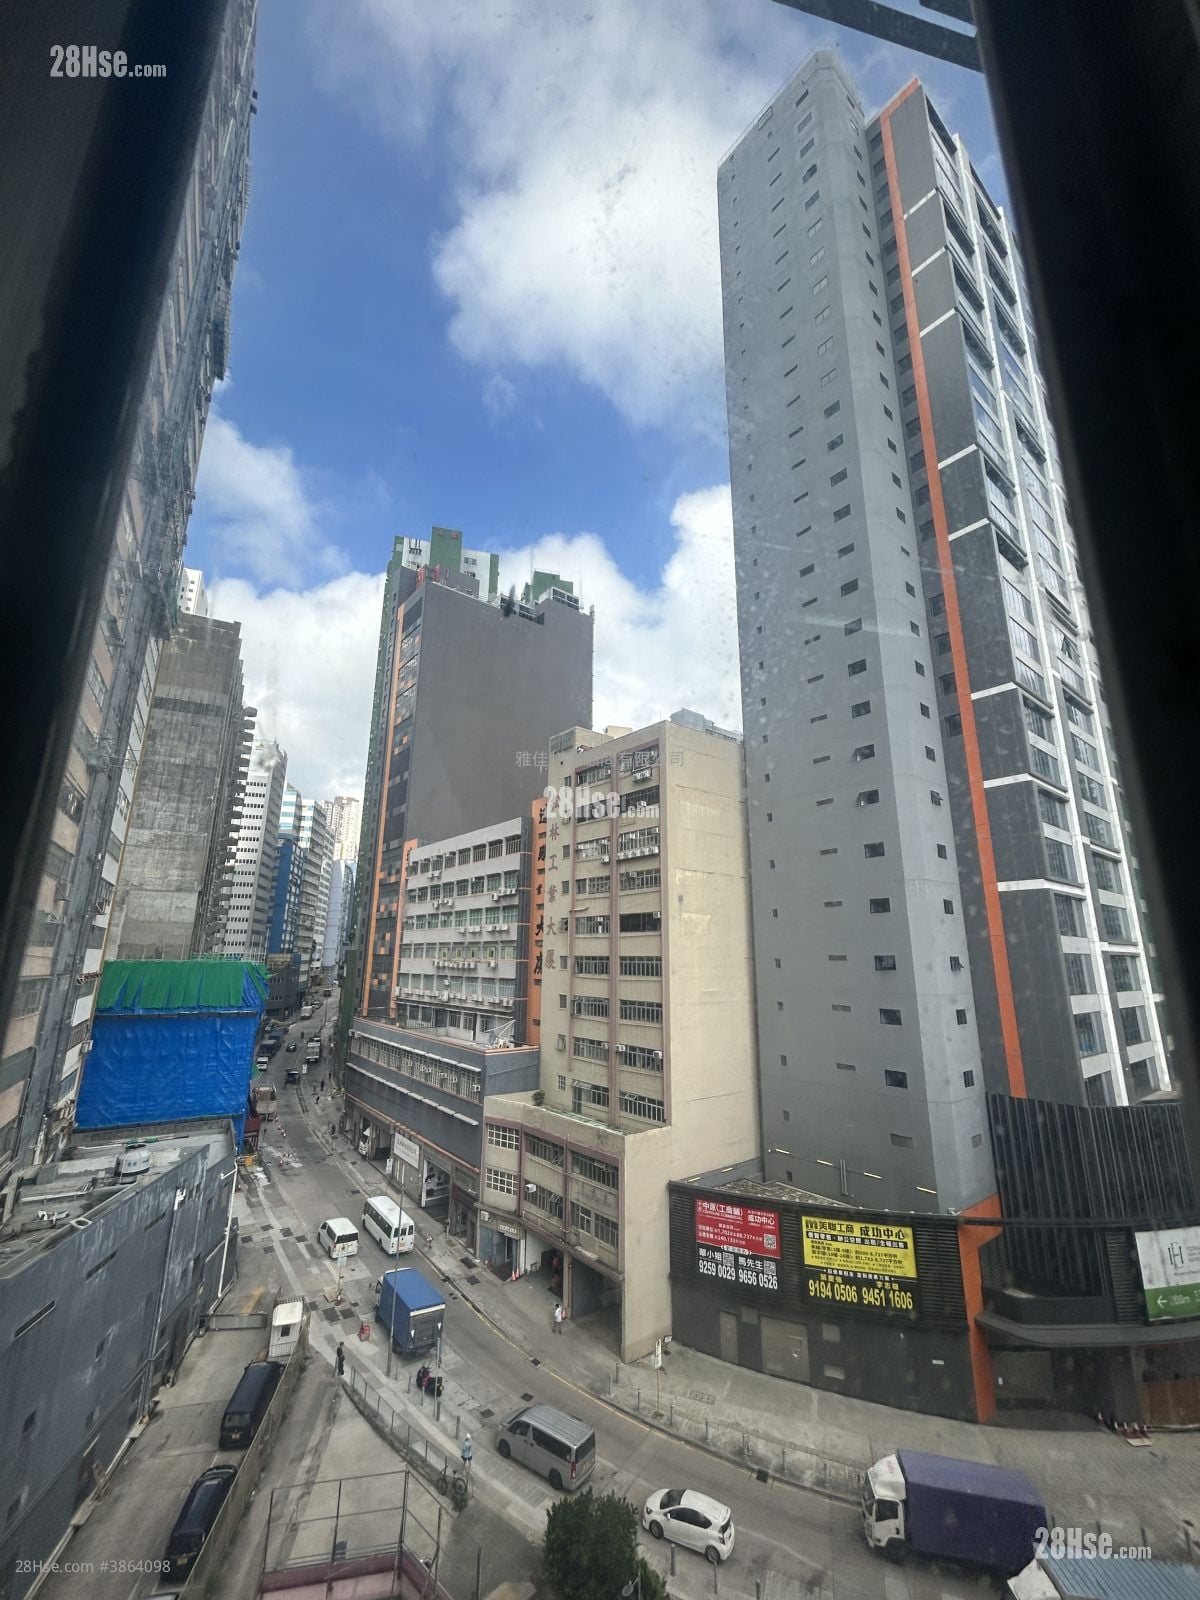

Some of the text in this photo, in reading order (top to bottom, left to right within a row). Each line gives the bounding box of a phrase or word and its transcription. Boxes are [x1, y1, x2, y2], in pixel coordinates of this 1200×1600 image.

[748, 1214, 775, 1225] 成功中心
[859, 1226, 906, 1240] 成功中心
[698, 1260, 716, 1276] 9259
[717, 1264, 736, 1281] 0029
[738, 1256, 764, 1270] 馬先生
[738, 1269, 757, 1286] 9656
[758, 1273, 778, 1290] 0526
[808, 1279, 858, 1303] 9194 0506
[862, 1287, 913, 1309] 9451 1606
